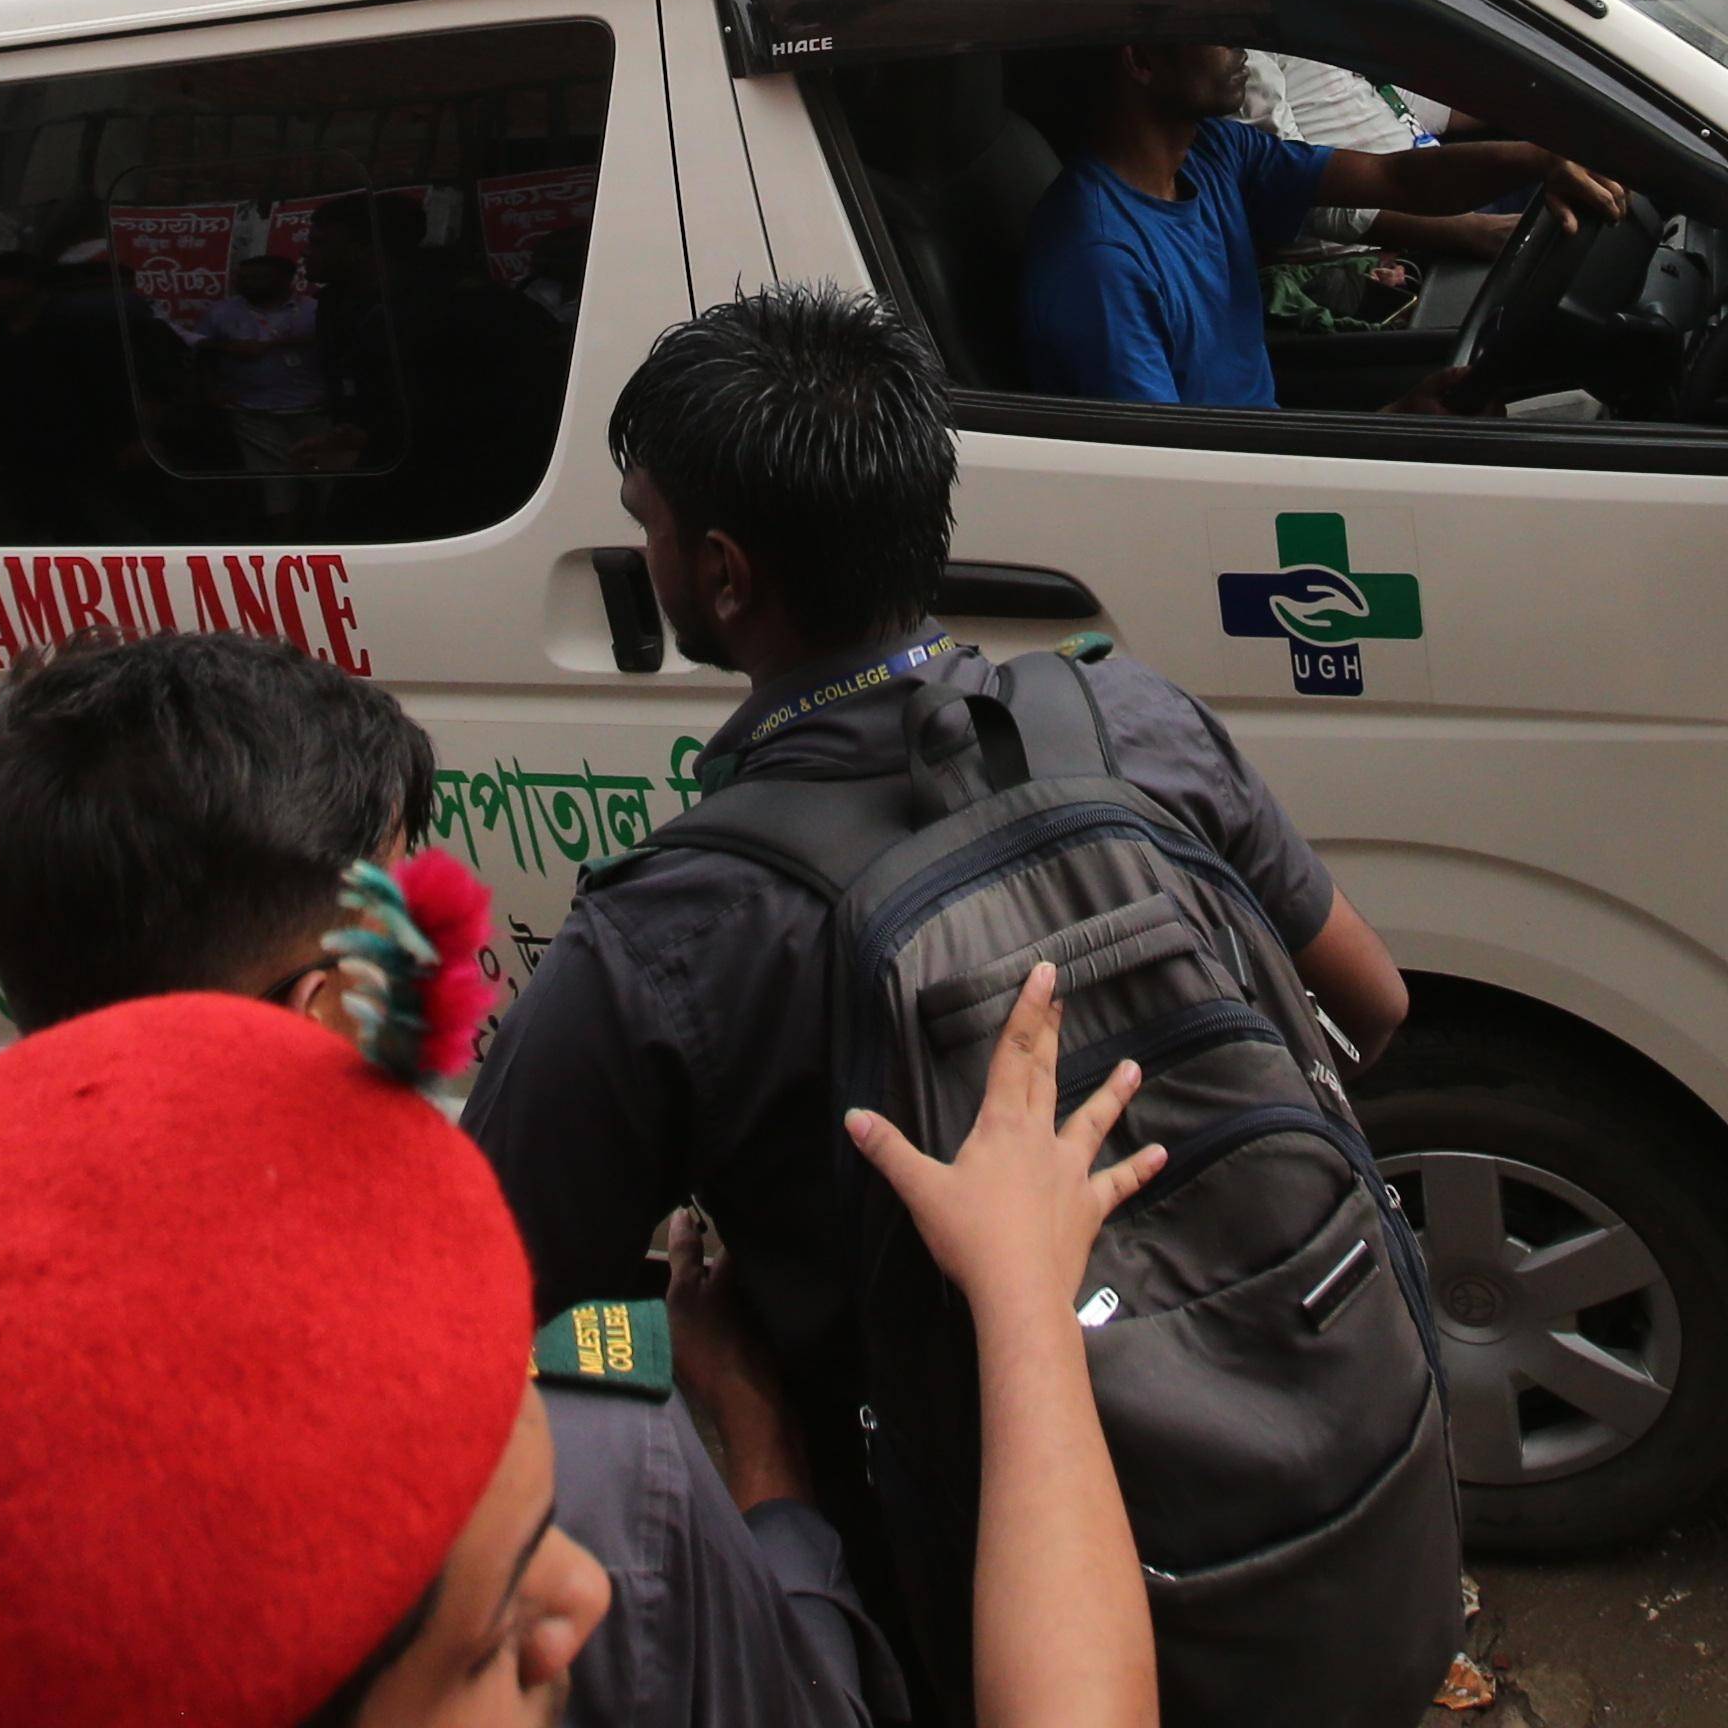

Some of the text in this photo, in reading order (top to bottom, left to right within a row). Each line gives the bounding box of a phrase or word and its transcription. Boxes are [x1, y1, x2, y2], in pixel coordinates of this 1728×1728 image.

[772, 37, 833, 56] HIACE
[1294, 654, 1360, 680] UGH
[751, 664, 891, 741] SCHOOL & COLLEGE
[430, 757, 655, 875] সপাতাল
